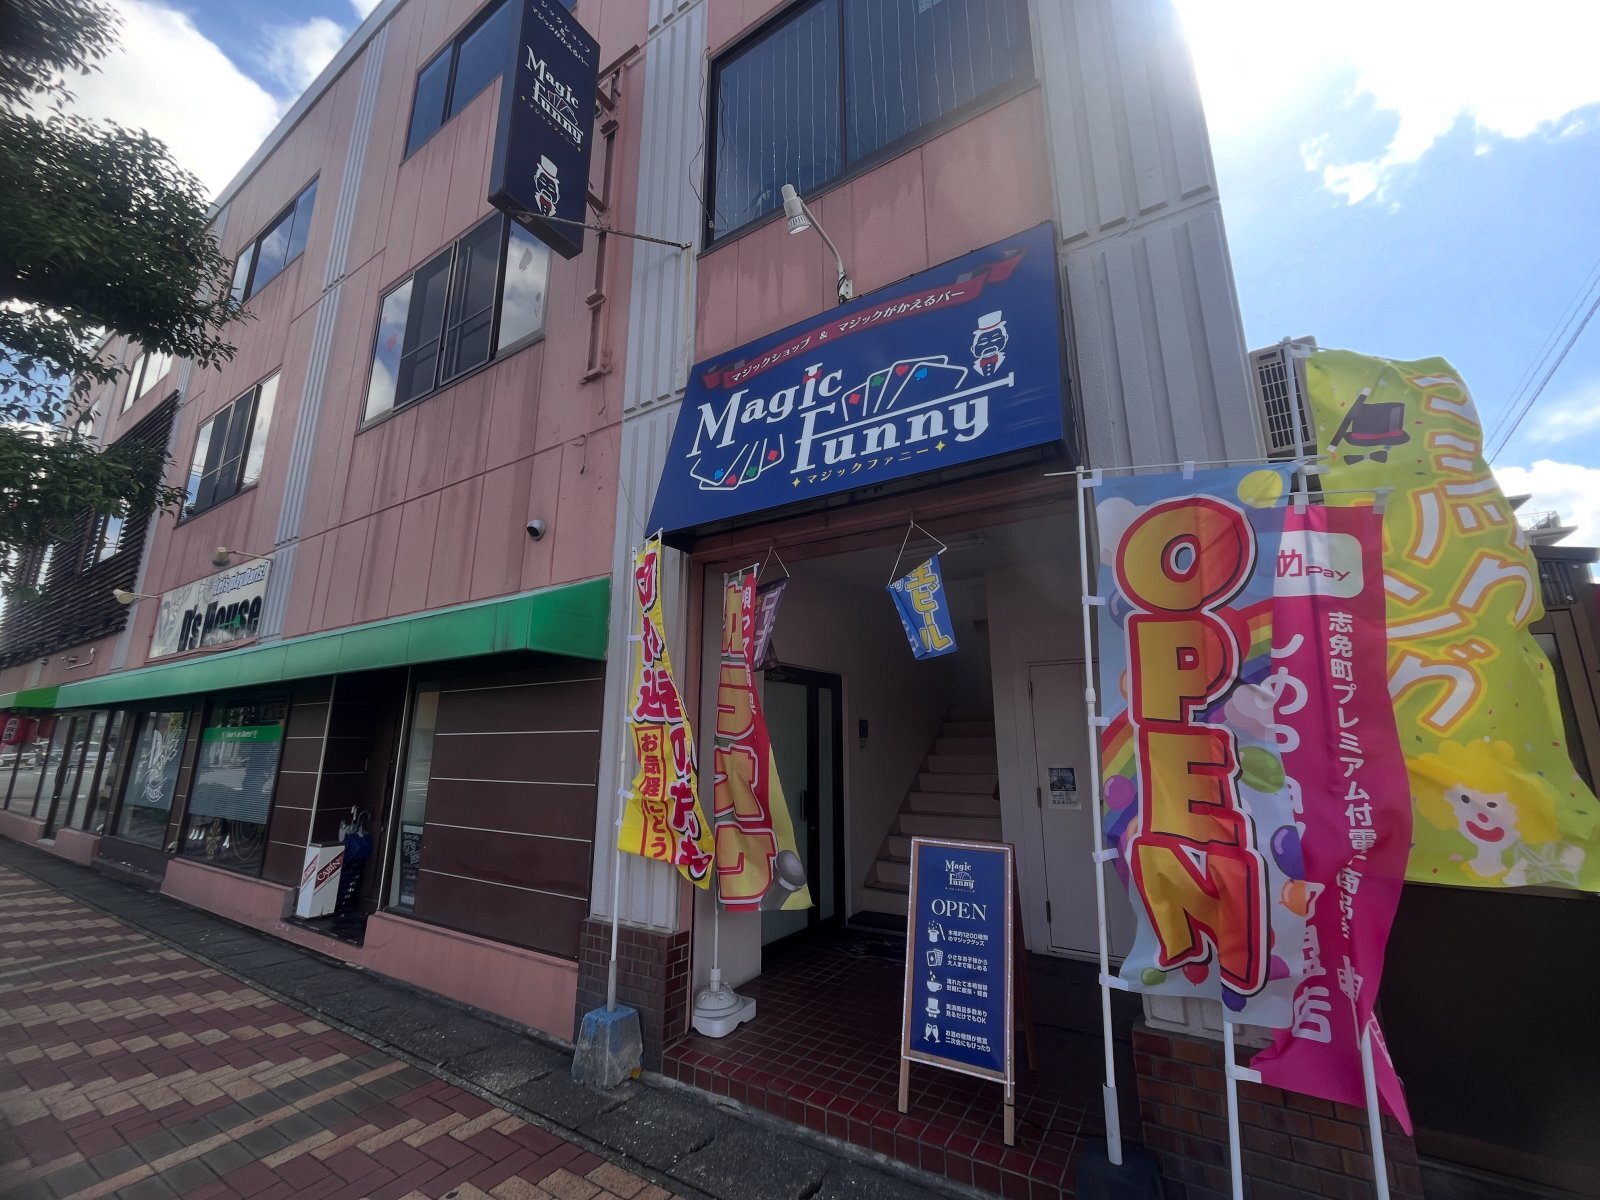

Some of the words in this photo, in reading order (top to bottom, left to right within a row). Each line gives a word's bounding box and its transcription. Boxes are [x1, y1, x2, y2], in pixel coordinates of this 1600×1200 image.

[525, 45, 579, 108] Magic
[532, 78, 583, 144] Funny
[731, 336, 812, 382] マジックショップ
[819, 331, 828, 340] &
[838, 290, 965, 332] マジックがかえるバー
[686, 362, 844, 458] Magic
[790, 373, 1014, 475] Funny
[807, 448, 929, 484] マジックファニー
[904, 558, 954, 652] 生ビール
[1112, 493, 1271, 998] OPEN
[640, 732, 669, 862] お気軽にどう
[317, 858, 341, 881] CABIN
[945, 860, 972, 872] Magic
[949, 873, 975, 889] Funny
[931, 899, 988, 921] OPEN
[947, 936, 985, 946] のマジックグッズ
[945, 1010, 987, 1024] 見るだけでもOK
